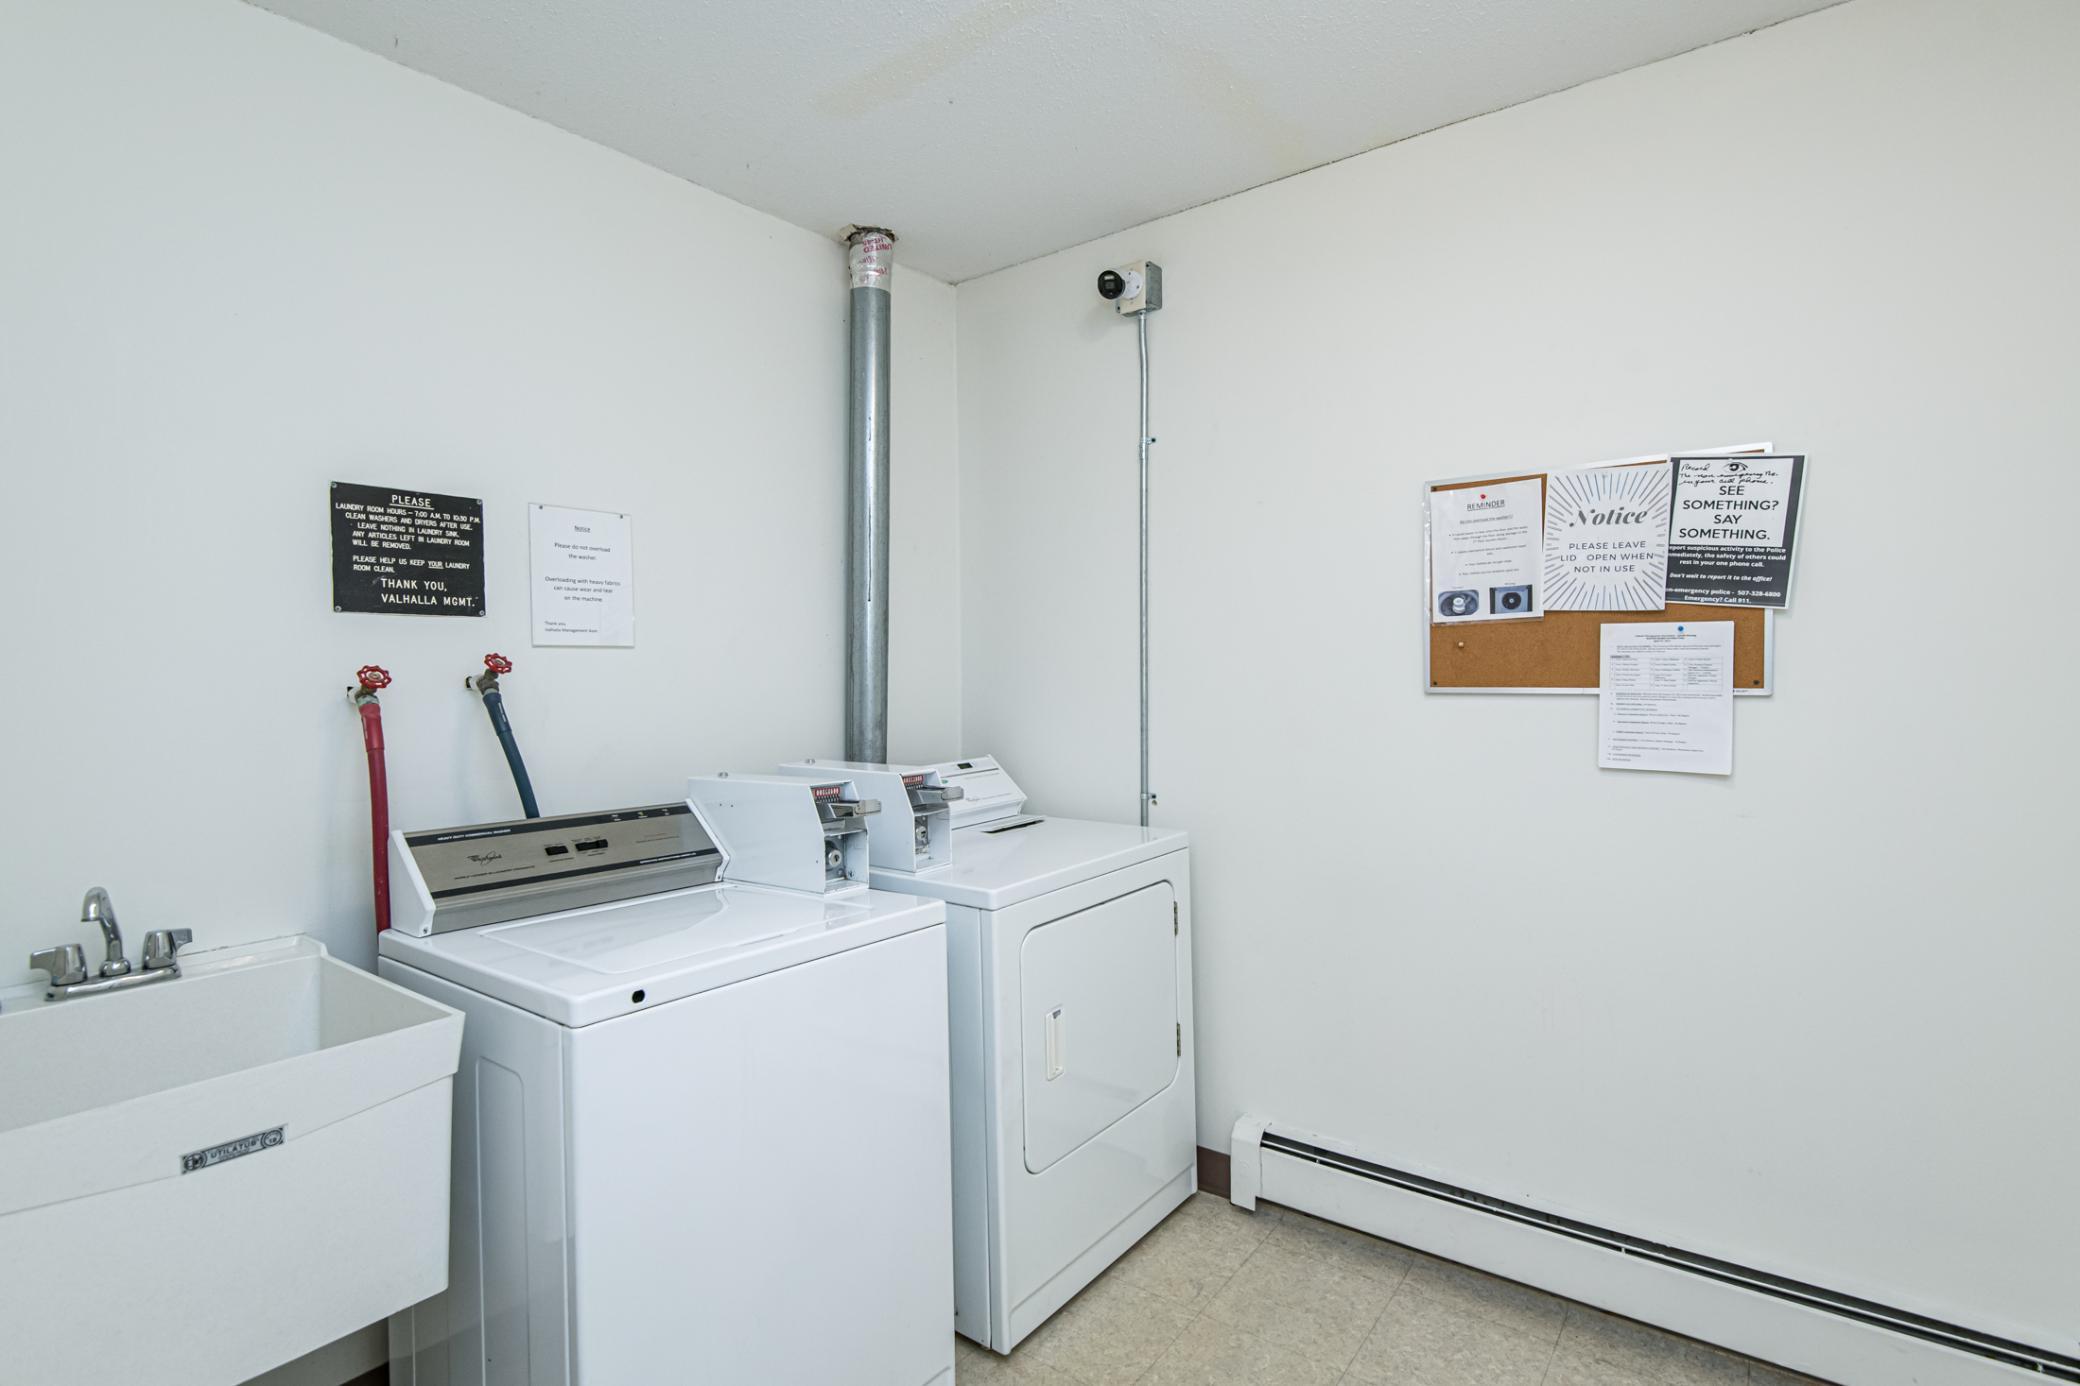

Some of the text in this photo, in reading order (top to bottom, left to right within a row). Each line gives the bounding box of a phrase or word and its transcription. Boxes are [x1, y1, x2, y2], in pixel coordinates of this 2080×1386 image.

[1719, 485, 1745, 496] SEE
[391, 494, 431, 508] PLEASE
[1467, 499, 1505, 511] REMINDER
[1682, 499, 1779, 511] SOMETHING?
[335, 502, 364, 511] LAUNDRY
[366, 505, 384, 513] ROOM
[386, 507, 407, 516] HOURS
[414, 510, 428, 518] 7:00
[345, 511, 366, 520] CLEAN
[368, 514, 398, 523] WASHERS
[400, 517, 412, 525] AND
[414, 518, 437, 527] DRYERS
[440, 521, 458, 529] AFTER
[1569, 506, 1648, 528] Notice
[1713, 514, 1742, 524] SAY
[357, 521, 377, 530] LEAVE
[380, 524, 406, 532] NOTHING
[417, 528, 442, 536] LAUNDRY
[1679, 528, 1770, 541] SOMETHING.
[367, 531, 397, 540] ARTICLES
[399, 534, 415, 542] LEFT
[426, 537, 452, 545] LAUNDRY
[454, 539, 470, 547] ROOM
[1568, 540, 1647, 551] PLEASE LEAVE
[352, 555, 377, 563] PLEASE
[1560, 552, 1654, 562] LID OPEN WHEN
[1716, 553, 1736, 561] safety
[352, 564, 371, 572] ROOM
[1574, 564, 1636, 573] NOT IN USE
[380, 578, 447, 592] THANK YOU,
[380, 593, 475, 608] VALHALLA MGMT.
[1684, 595, 1722, 603] Emergency?
